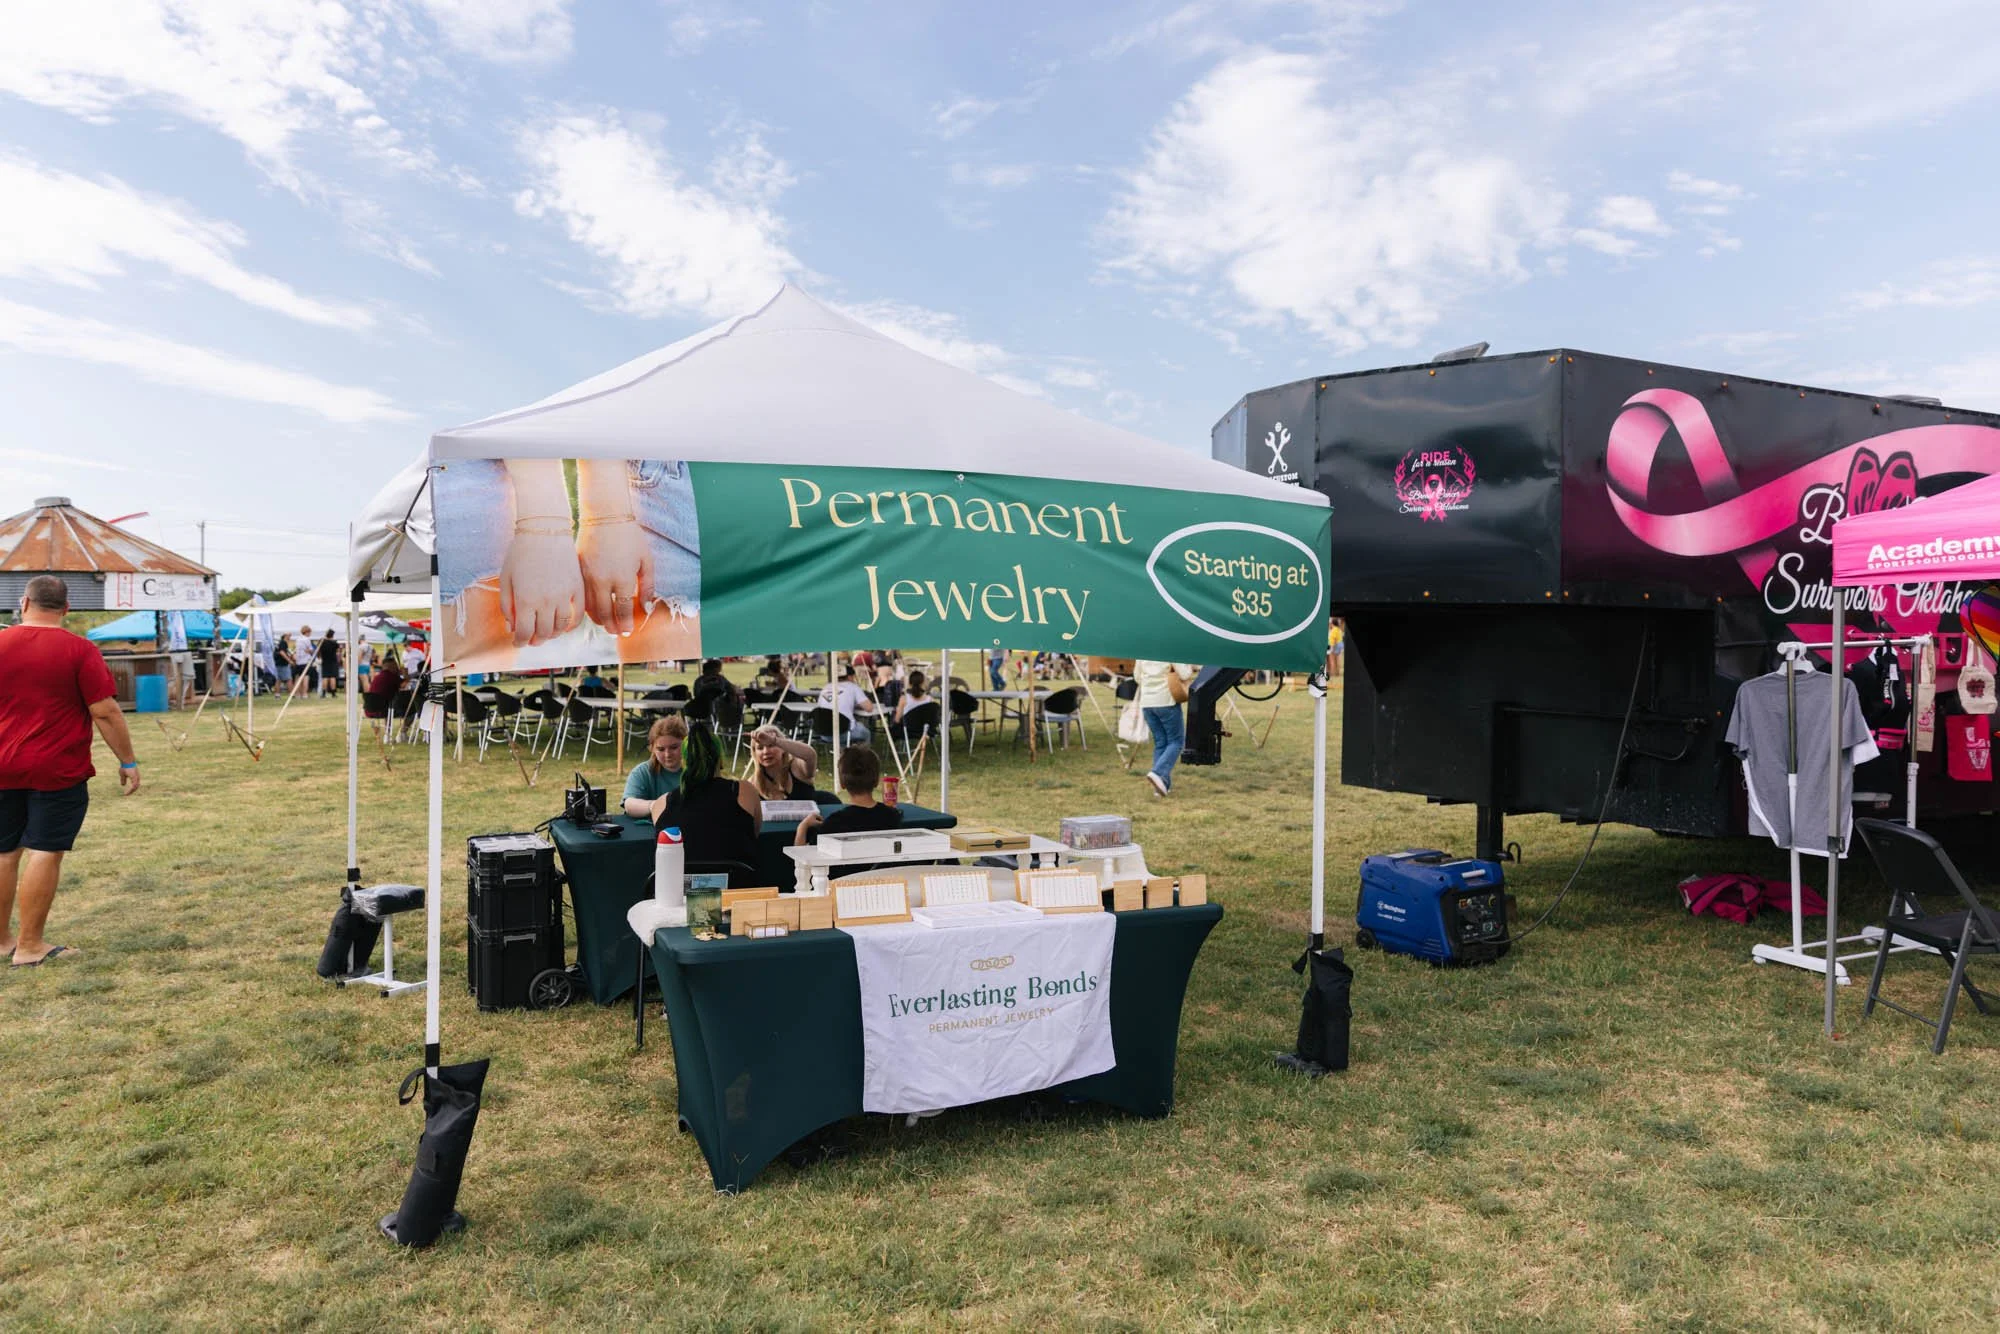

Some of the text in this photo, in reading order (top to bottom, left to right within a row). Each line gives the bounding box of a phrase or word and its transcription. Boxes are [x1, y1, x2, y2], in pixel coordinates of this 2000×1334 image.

[1421, 451, 1450, 462] RIDE
[779, 477, 1133, 546] Permanent
[1183, 549, 1309, 587] Starting at
[857, 564, 1090, 640] Jewelry
[1231, 588, 1273, 618] $35
[888, 970, 1097, 1018] Everlasting Bonds
[928, 1007, 1055, 1033] PERMANENT JEWELRY
